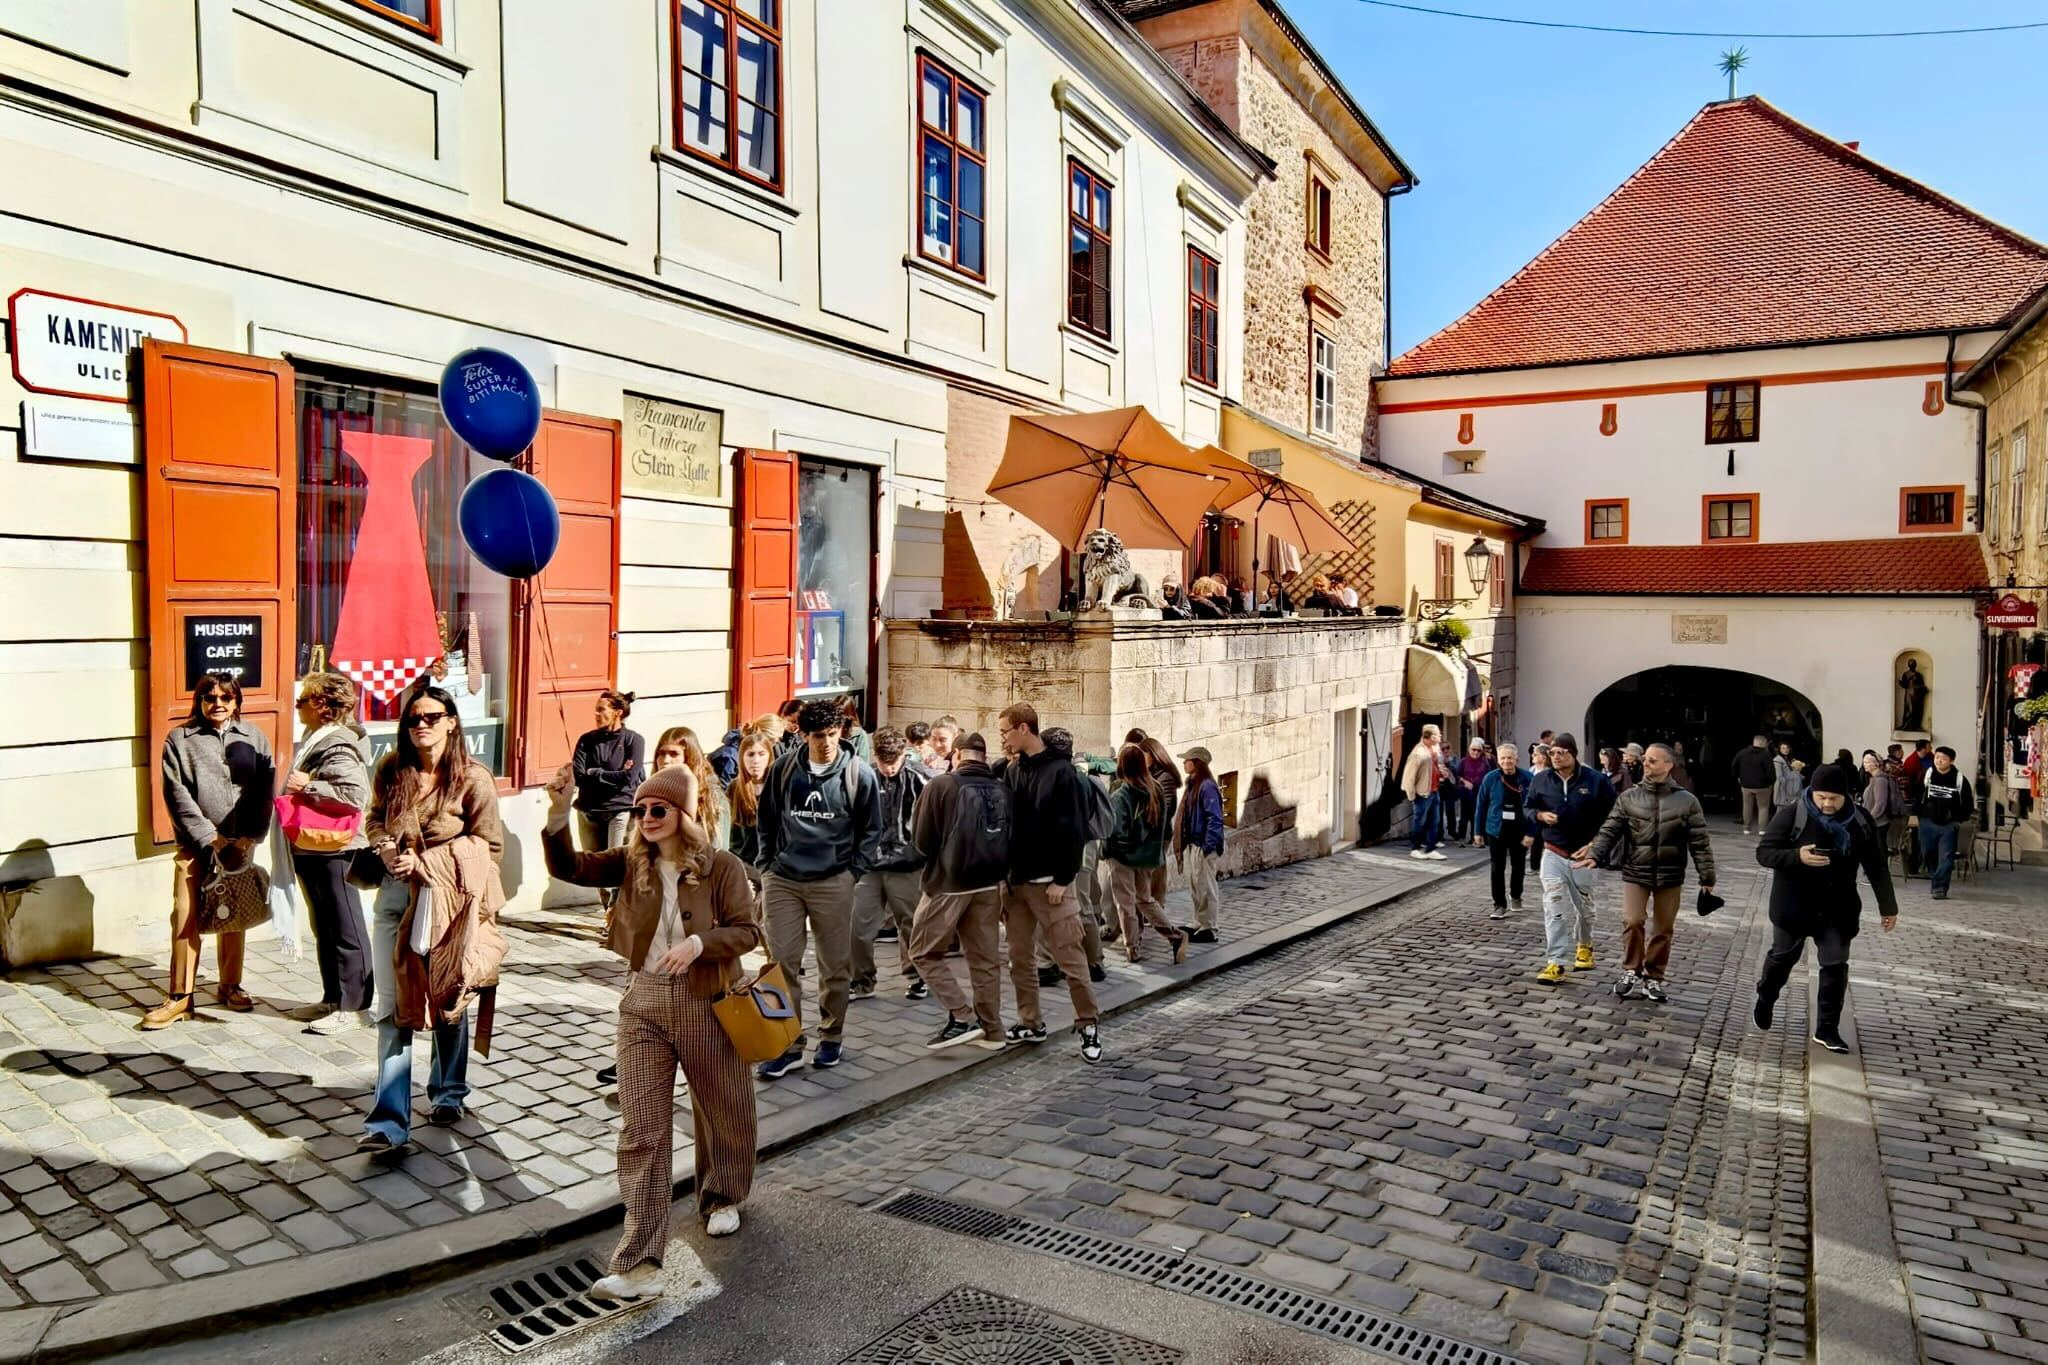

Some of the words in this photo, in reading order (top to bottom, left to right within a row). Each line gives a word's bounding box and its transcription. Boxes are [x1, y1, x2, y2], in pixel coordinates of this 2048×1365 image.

[77, 362, 132, 383] ULIC
[466, 374, 502, 393] SUPER
[506, 375, 518, 385] JE
[468, 388, 490, 404] BITI
[632, 449, 675, 477] Stein
[1986, 615, 2036, 624] SUVENIRNICA
[194, 623, 253, 637] MUSEUM
[206, 642, 244, 658] CAFÉ
[790, 810, 835, 820] HEAD
